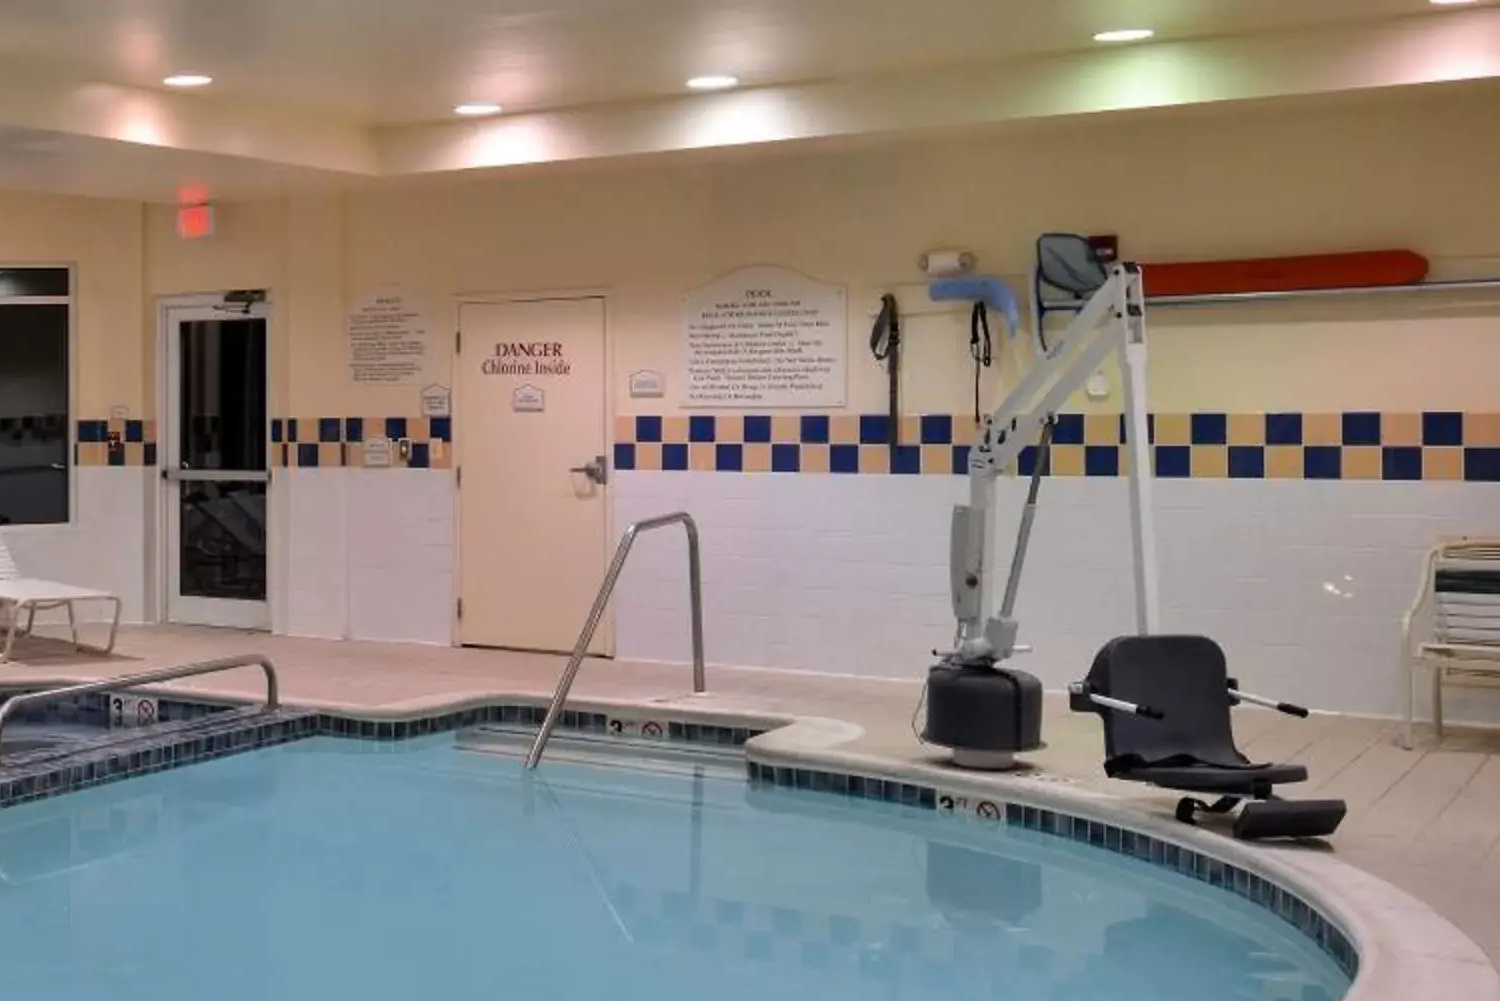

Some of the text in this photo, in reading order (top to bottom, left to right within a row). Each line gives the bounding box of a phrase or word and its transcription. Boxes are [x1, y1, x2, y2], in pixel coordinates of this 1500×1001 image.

[495, 342, 563, 357] DANGER
[480, 358, 571, 375] Chlorine Inside
